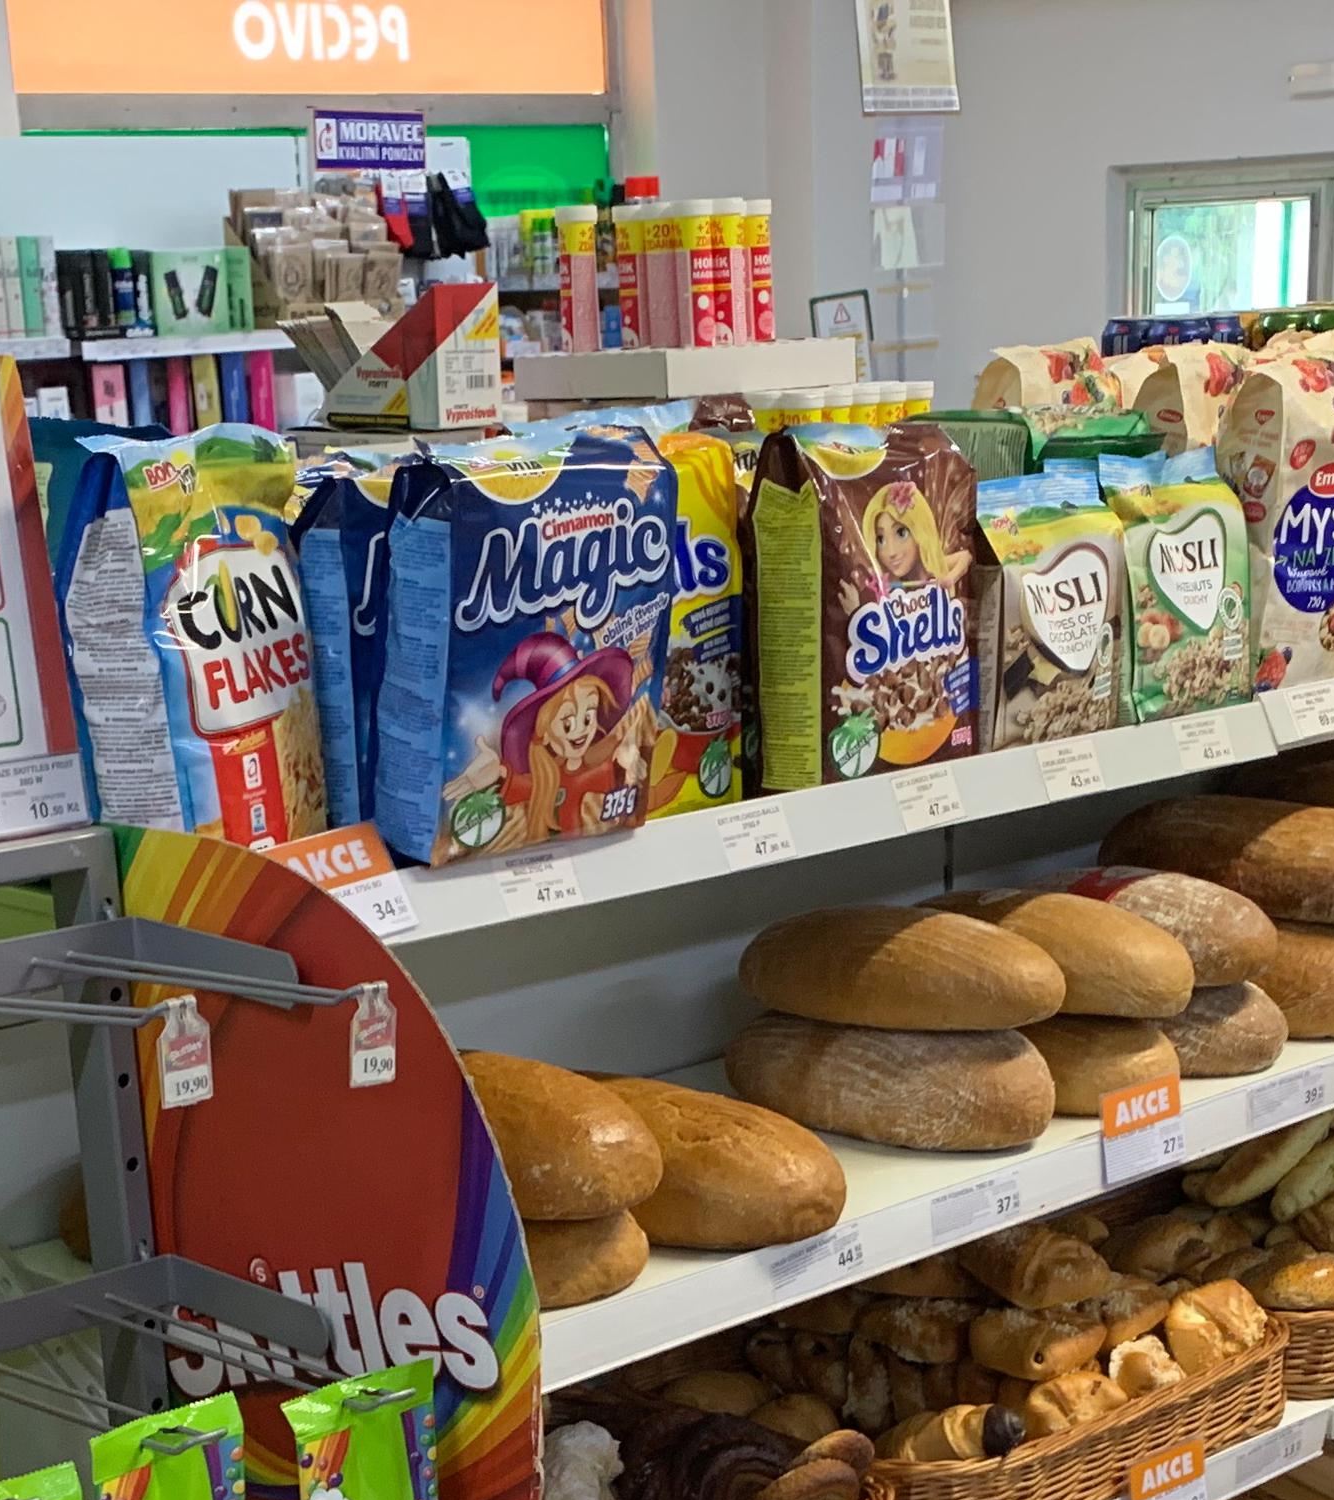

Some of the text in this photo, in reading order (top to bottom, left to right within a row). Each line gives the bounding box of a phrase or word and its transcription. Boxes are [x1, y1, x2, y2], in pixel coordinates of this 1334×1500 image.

[339, 121, 422, 142] MORAVEC
[541, 511, 615, 541] Cinnamon
[455, 497, 671, 633] Magic
[1293, 549, 1318, 568] NA
[178, 564, 299, 650] CORN
[890, 591, 932, 619] Choco
[853, 587, 962, 675] Shells
[203, 632, 311, 711] FLAKES
[287, 837, 373, 883] AKCE
[373, 900, 395, 921] 34
[362, 1055, 394, 1076] 19,90
[174, 1074, 209, 1097] 19,90
[1304, 1088, 1318, 1104] 39
[1115, 1087, 1171, 1129] AKCE
[1162, 1136, 1177, 1154] 27
[995, 1196, 1012, 1214] 37
[837, 1247, 855, 1268] 44
[1141, 1450, 1194, 1494] AKCE
